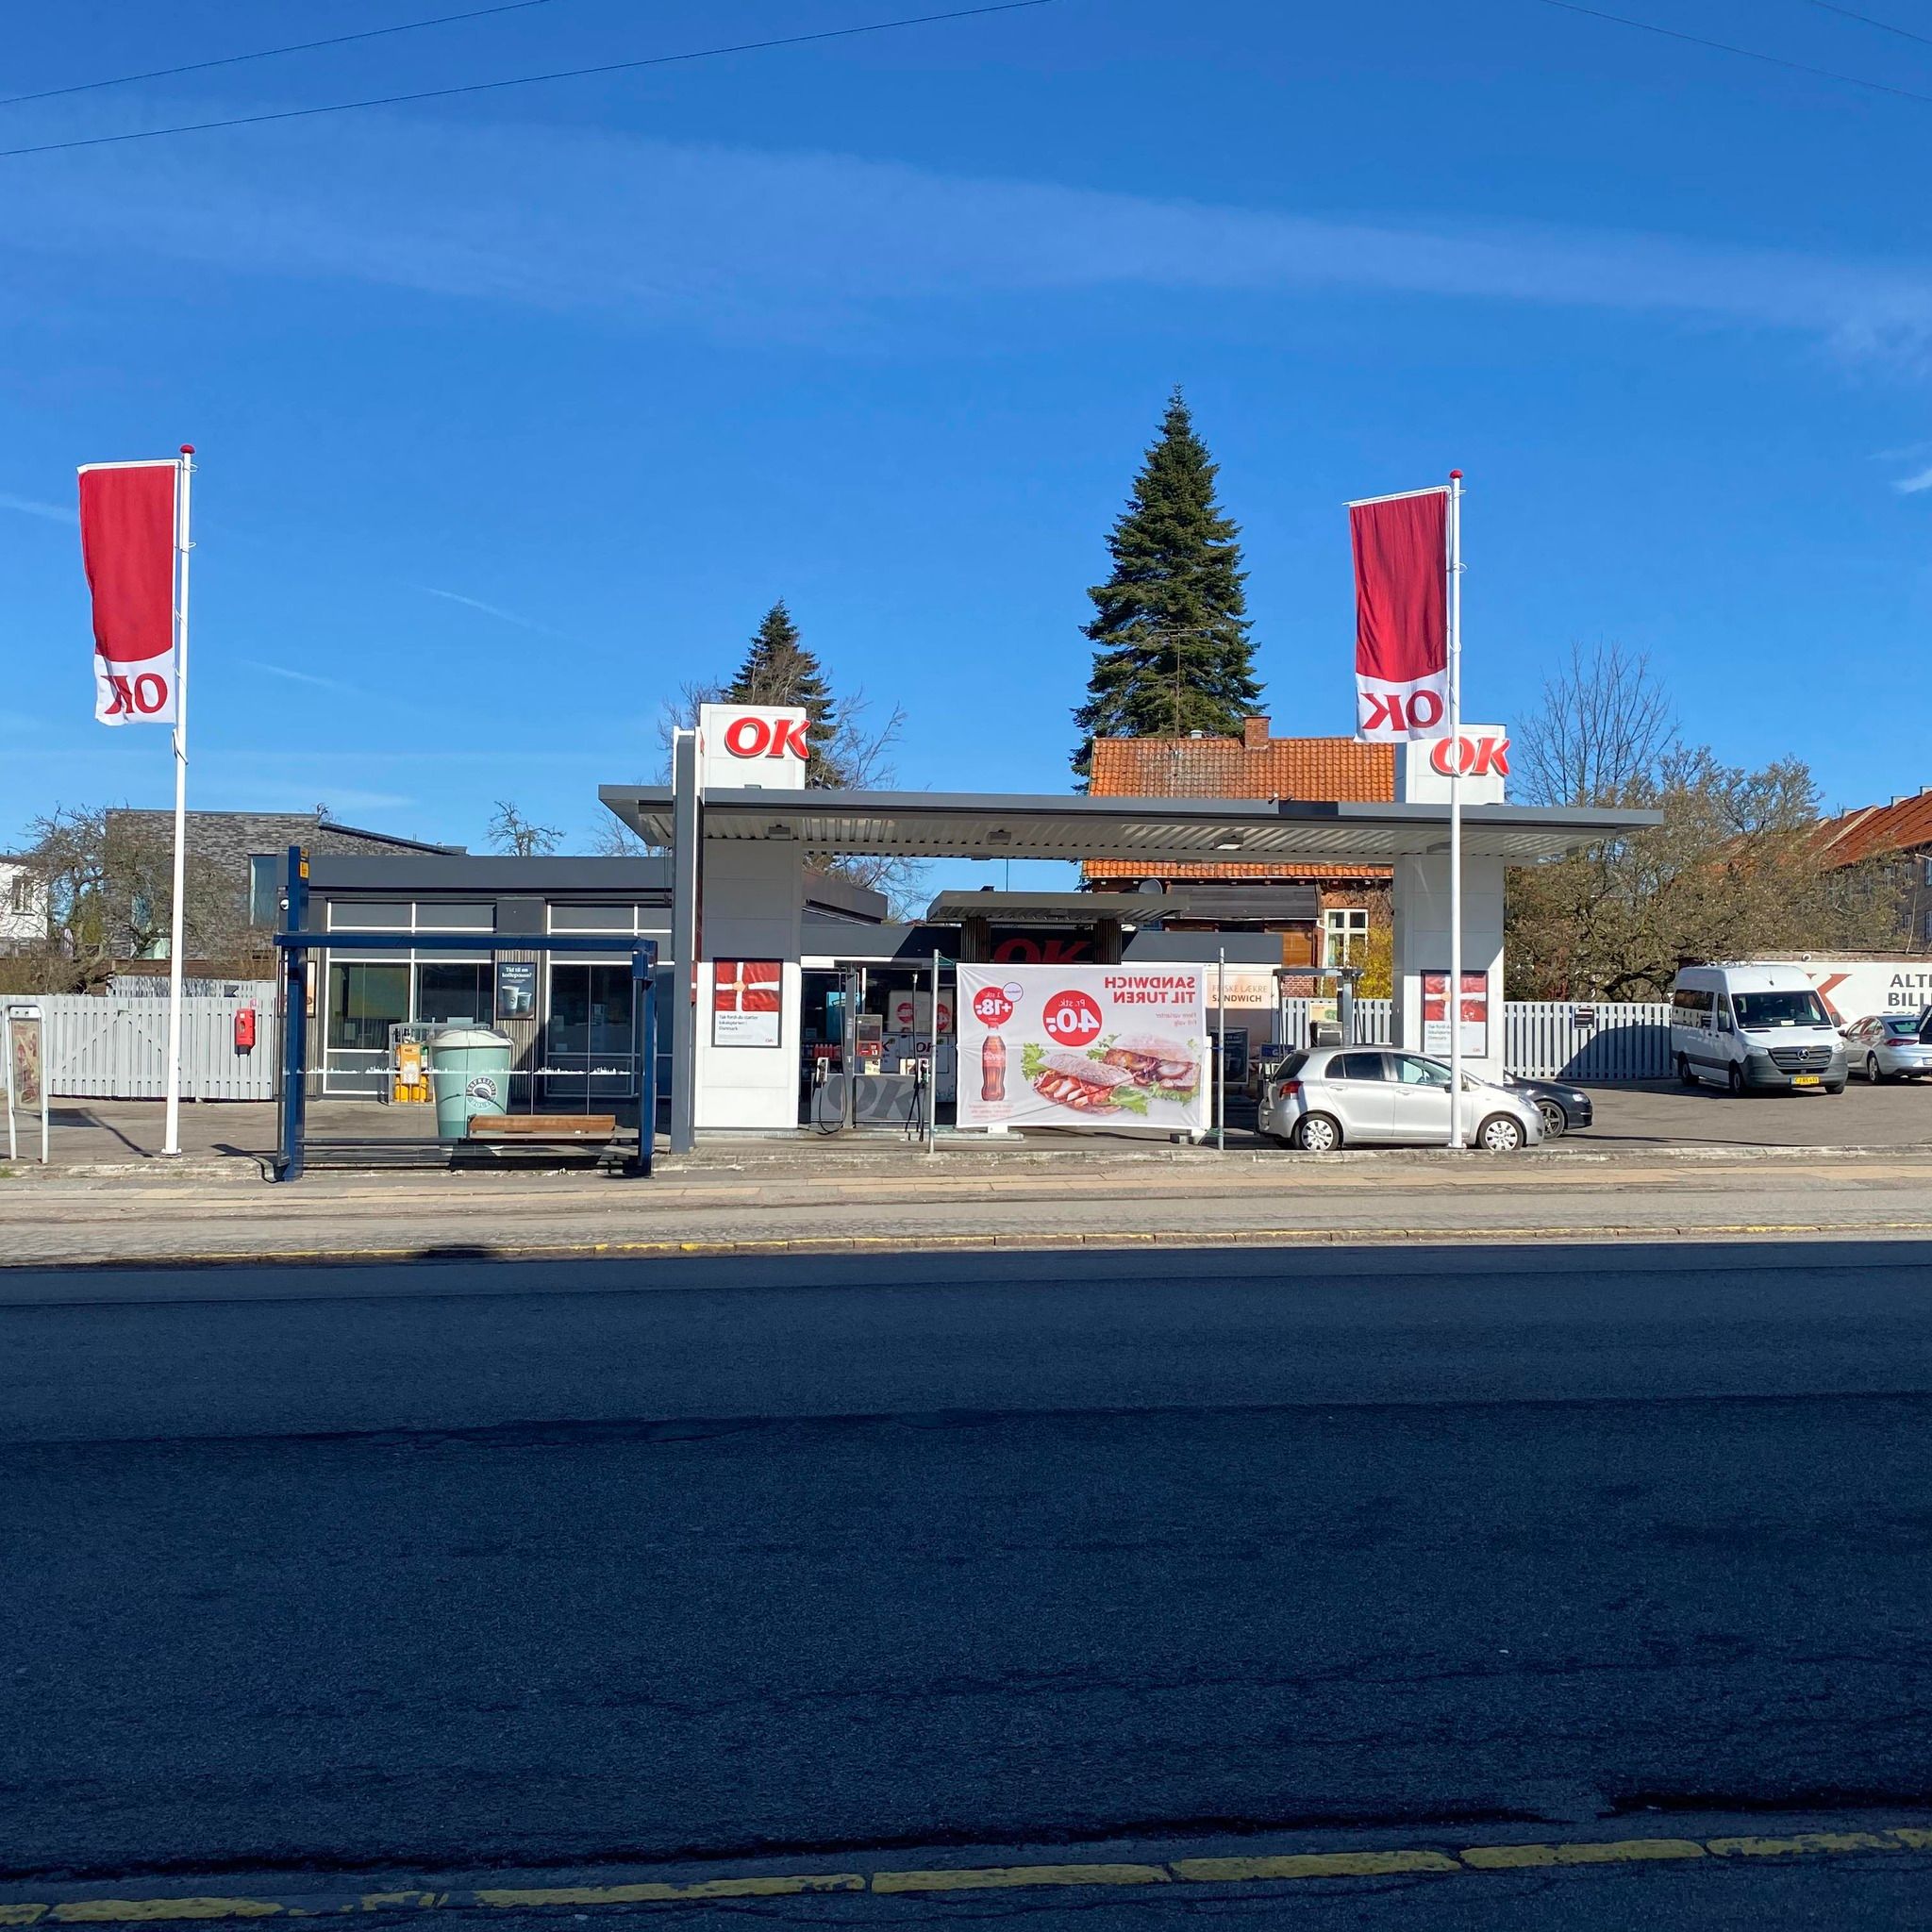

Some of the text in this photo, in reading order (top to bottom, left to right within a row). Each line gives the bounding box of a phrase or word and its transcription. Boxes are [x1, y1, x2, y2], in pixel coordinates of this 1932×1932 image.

[724, 717, 811, 761] OK
[1430, 735, 1511, 776] OK
[993, 938, 1092, 963] OK
[1212, 994, 1262, 1003] SNDWICH
[1888, 992, 1932, 1007] BILL
